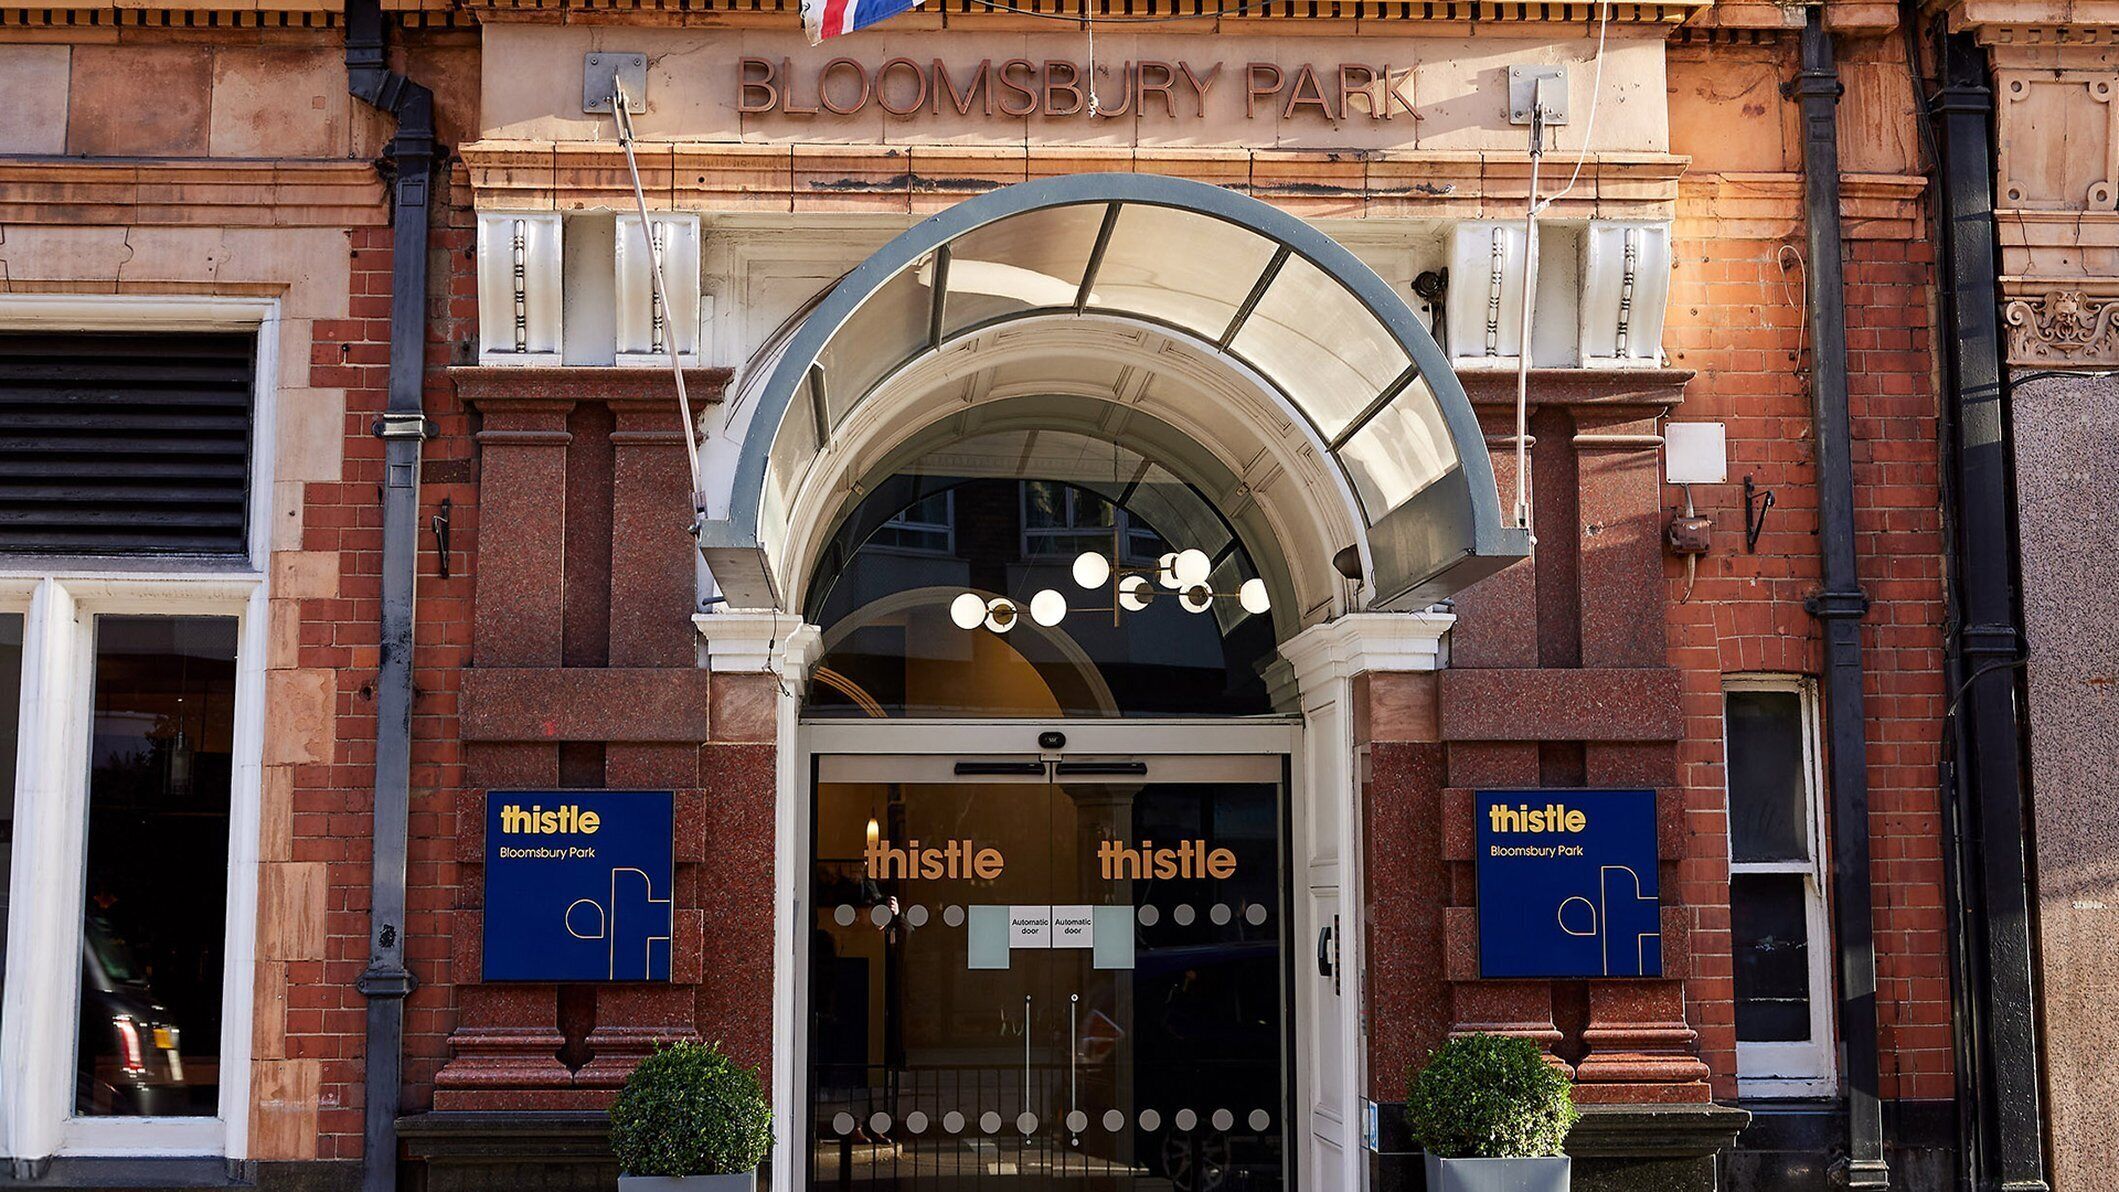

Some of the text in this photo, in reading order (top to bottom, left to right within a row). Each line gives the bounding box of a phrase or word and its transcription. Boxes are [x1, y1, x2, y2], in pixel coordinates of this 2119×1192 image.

[737, 56, 1426, 120] BLOOMSBURY PARK
[500, 805, 600, 834] thistle
[1489, 804, 1586, 833] thistle
[500, 846, 596, 860] Bloomsbury Park
[1490, 845, 1584, 858] Bloomsbury Park
[864, 840, 1005, 879] thistle
[1097, 840, 1238, 879] thistle
[1012, 918, 1048, 926] Automatic
[1055, 918, 1091, 926] Automatic
[1021, 927, 1039, 935] door
[1064, 927, 1082, 935] door
